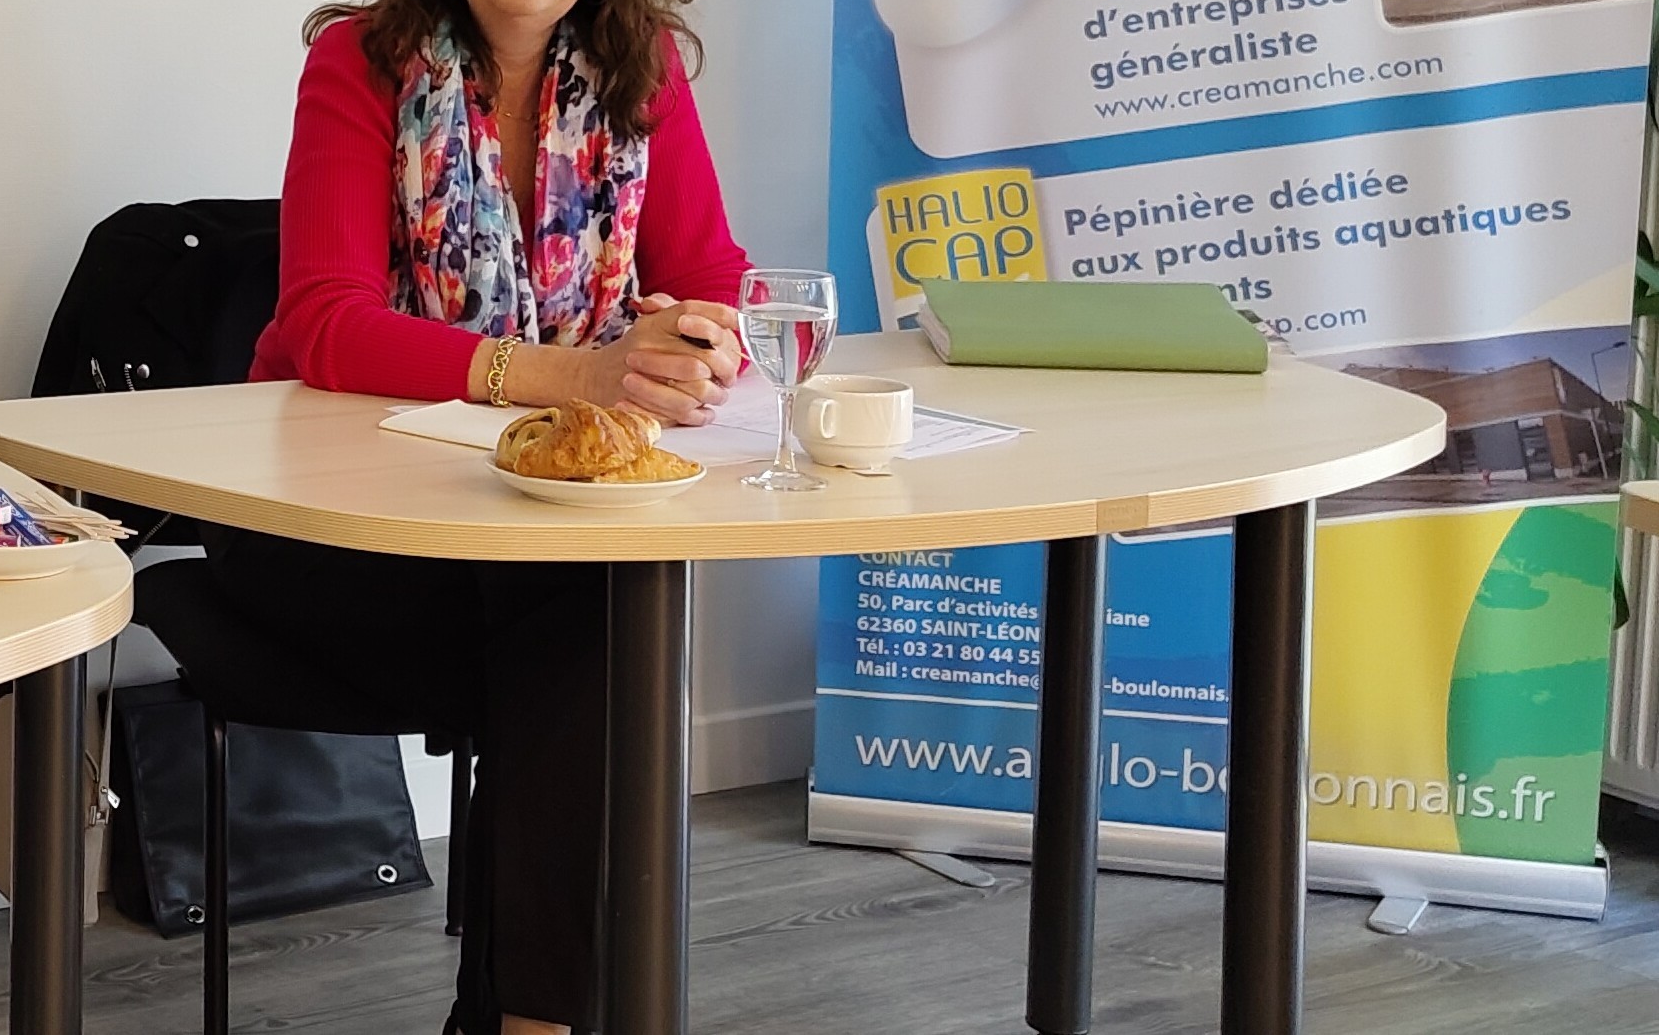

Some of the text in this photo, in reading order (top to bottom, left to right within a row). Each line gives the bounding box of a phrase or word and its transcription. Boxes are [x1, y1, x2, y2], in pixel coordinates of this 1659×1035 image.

[1089, 28, 1318, 90] généraliste
[1094, 52, 1444, 120] www.creamanche.com
[887, 182, 1029, 234] HALIO
[1063, 168, 1409, 237] Pépinière dédiée
[895, 225, 1033, 284] CAP
[1072, 195, 1572, 278] aux produits aquatiques
[859, 551, 953, 568] CONTACT
[858, 568, 1002, 595] CRÉAMANCHE
[858, 593, 887, 612] 50,
[891, 595, 933, 613] Parc
[857, 617, 1041, 642] 62360 SAINT-LÉON
[856, 636, 889, 656] Tél.
[903, 642, 927, 657] 03
[931, 643, 954, 659] 21
[959, 645, 984, 661] 80
[988, 646, 1014, 663] 44
[1018, 648, 1040, 665] 55
[856, 659, 897, 678] Mail
